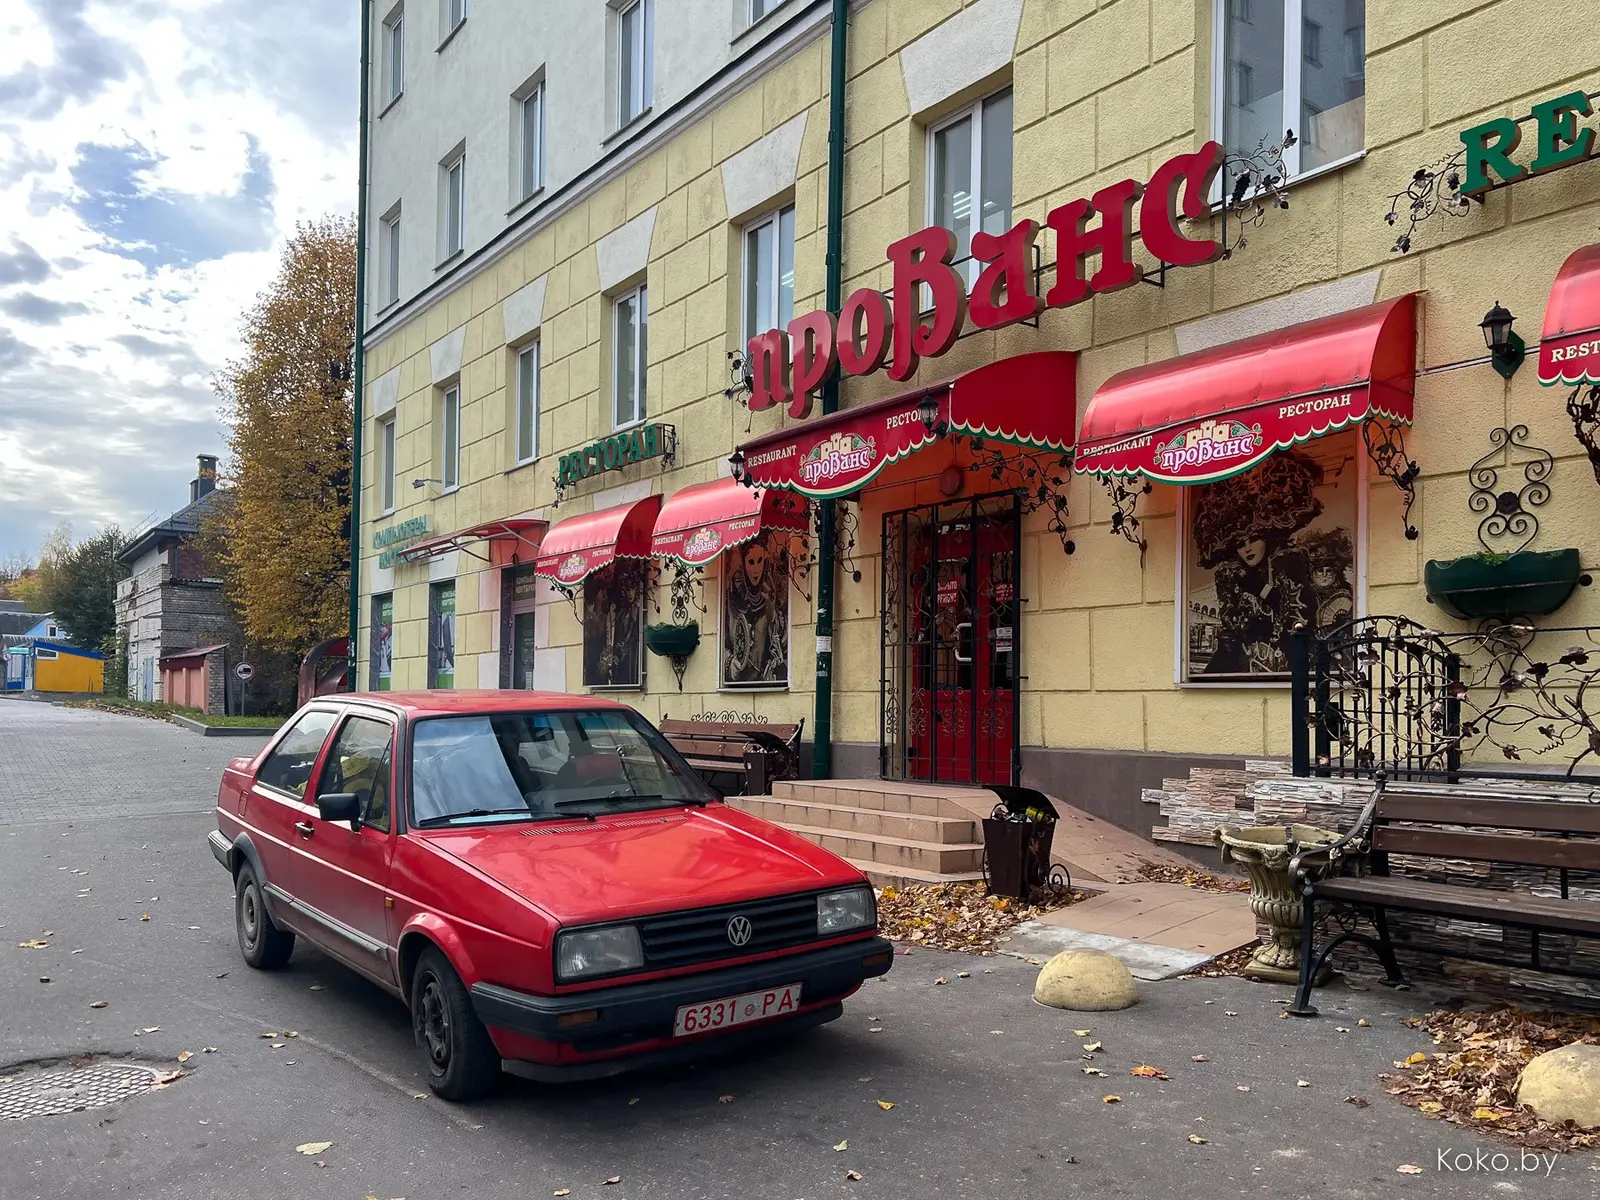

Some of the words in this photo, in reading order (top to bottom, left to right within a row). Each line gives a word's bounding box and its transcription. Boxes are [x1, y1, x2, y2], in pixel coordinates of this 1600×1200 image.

[1550, 340, 1600, 362] REST
[1278, 393, 1352, 420] РЕСТОРАН
[886, 408, 939, 430] РЕСТО
[558, 423, 660, 486] РЕСТОРАН
[747, 445, 797, 468] RESTAURANT
[1083, 436, 1153, 458] RESTAURANT
[727, 519, 756, 531] РЕСТОРАН
[683, 1000, 737, 1032] 6331
[762, 988, 794, 1016] PA
